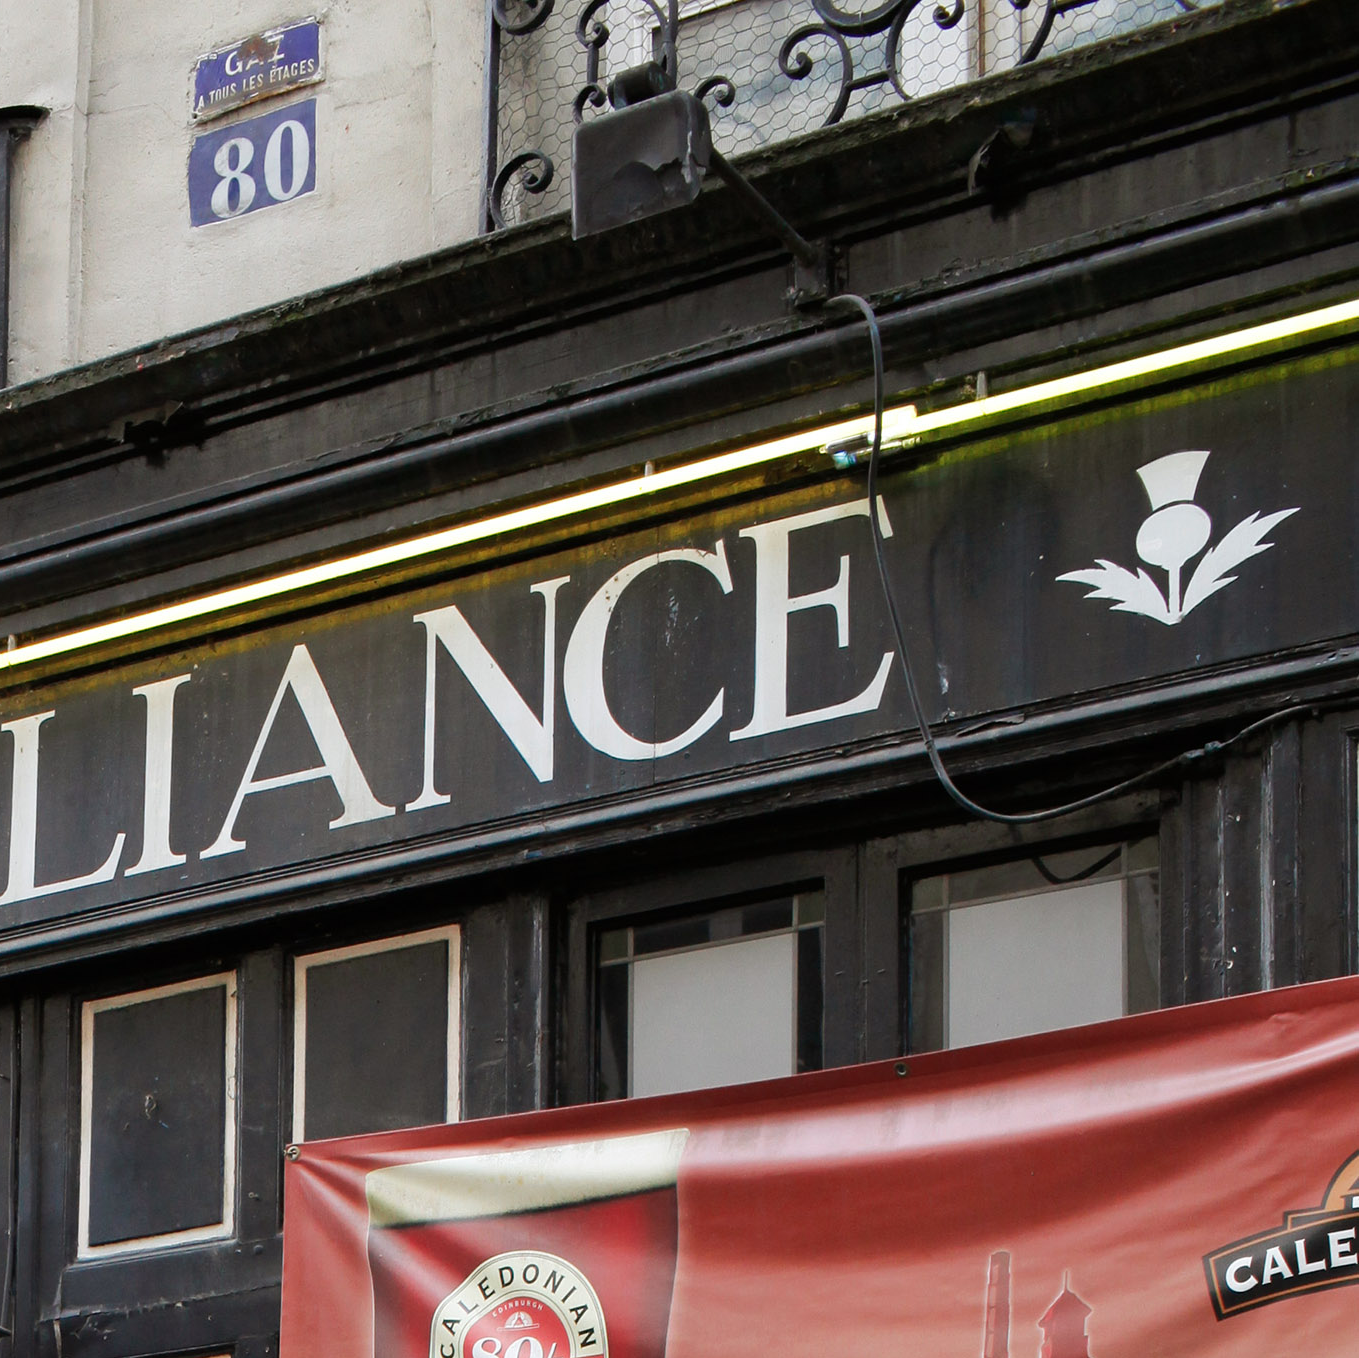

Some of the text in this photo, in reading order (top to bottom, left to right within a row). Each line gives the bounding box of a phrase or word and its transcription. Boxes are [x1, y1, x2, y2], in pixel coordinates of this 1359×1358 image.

[209, 82, 237, 104] TOUS
[243, 73, 264, 92] LES
[210, 119, 310, 219] 80
[492, 1300, 544, 1318] EDINBURGH
